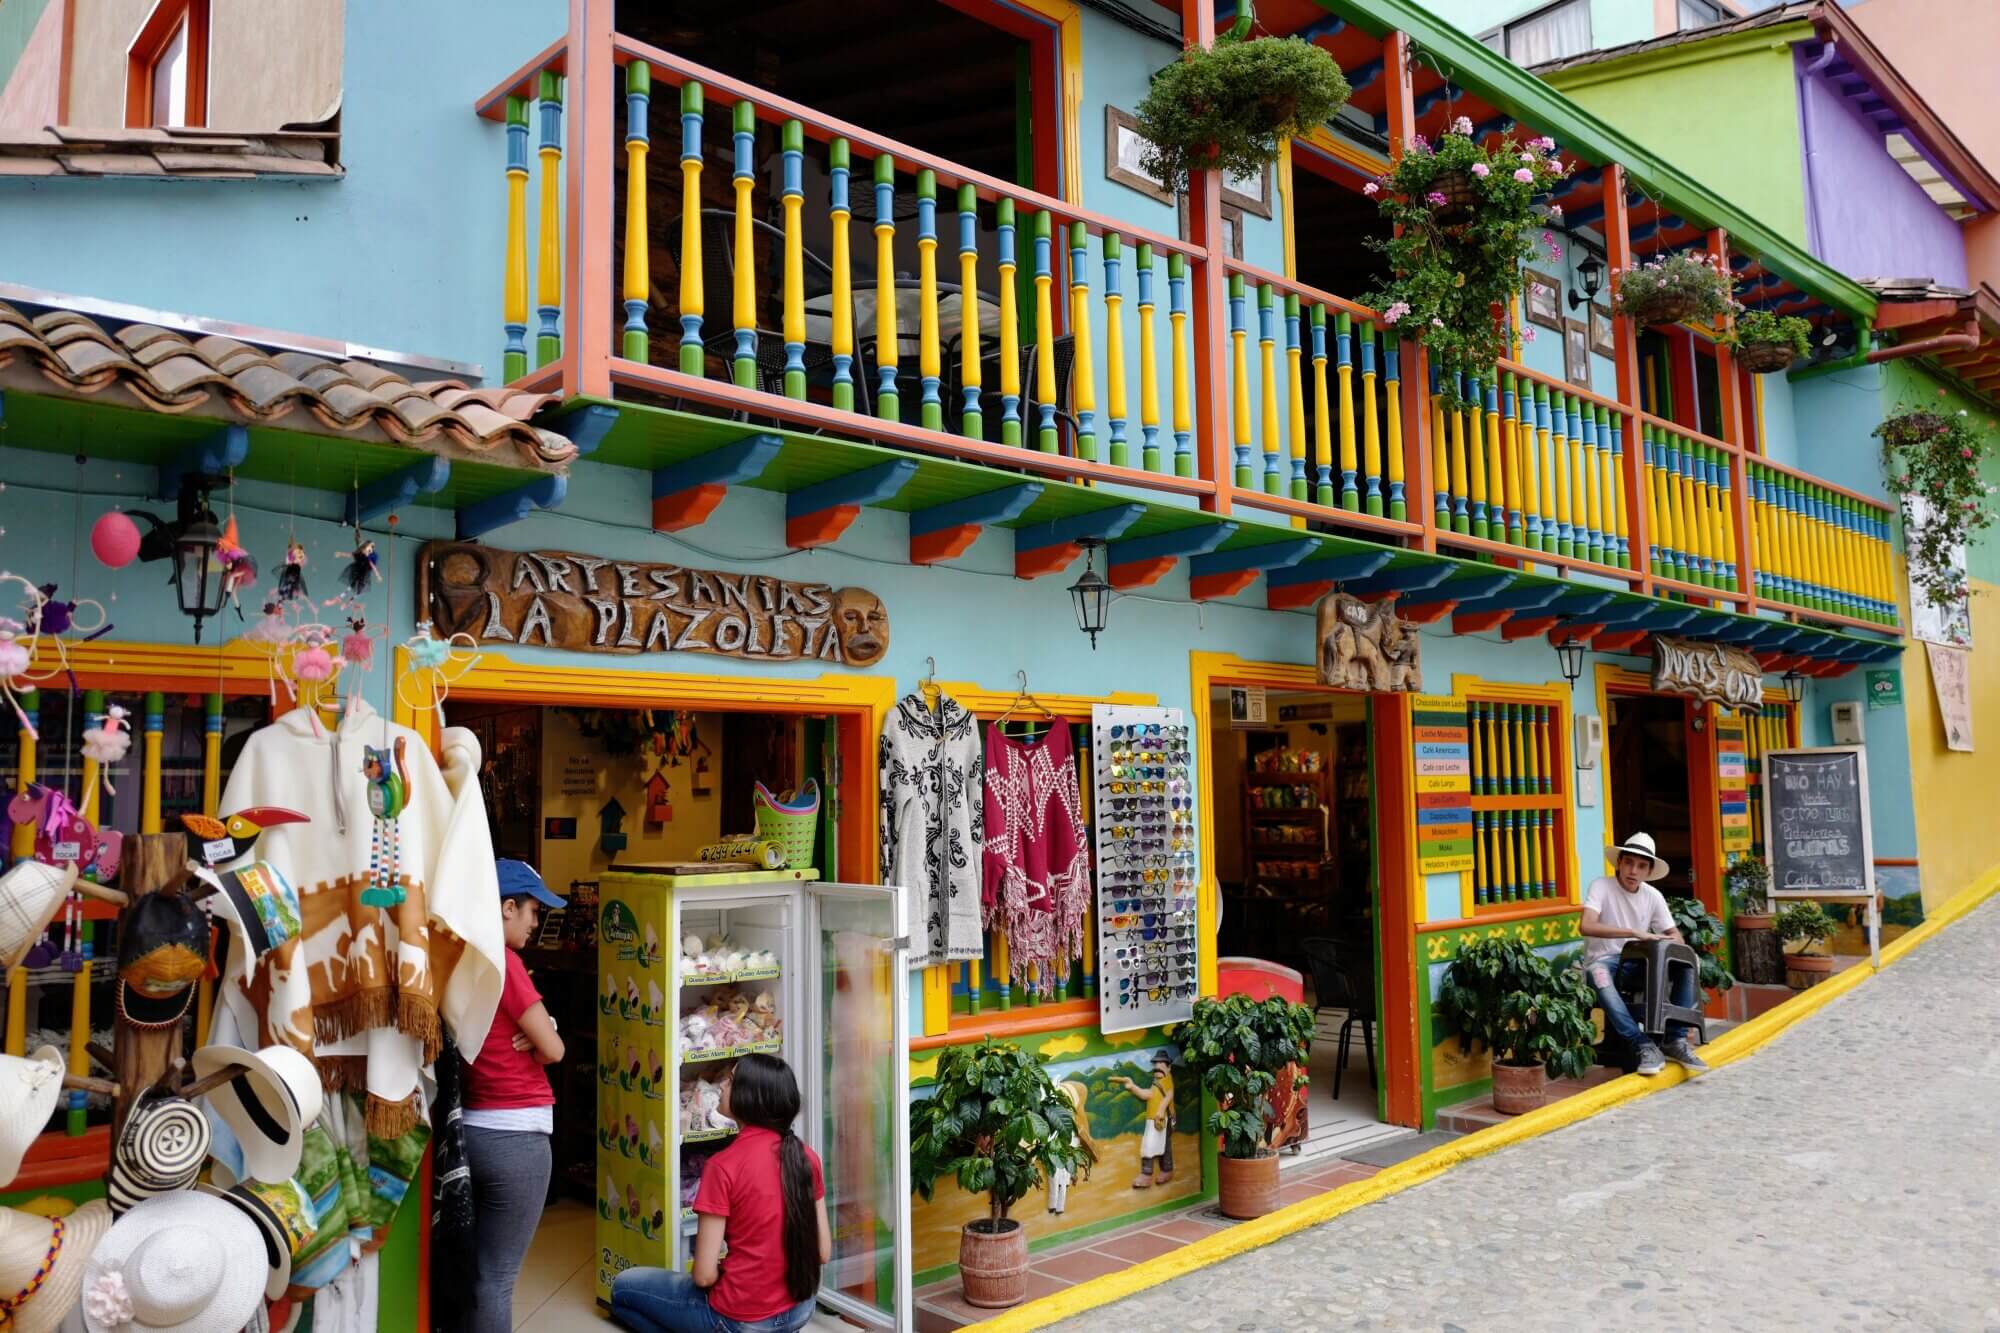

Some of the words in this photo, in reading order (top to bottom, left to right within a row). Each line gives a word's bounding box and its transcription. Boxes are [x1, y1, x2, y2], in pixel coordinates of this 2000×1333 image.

[481, 591, 553, 647] LA
[586, 598, 841, 662] PLAZOLETA
[1817, 774, 1841, 791] HAY
